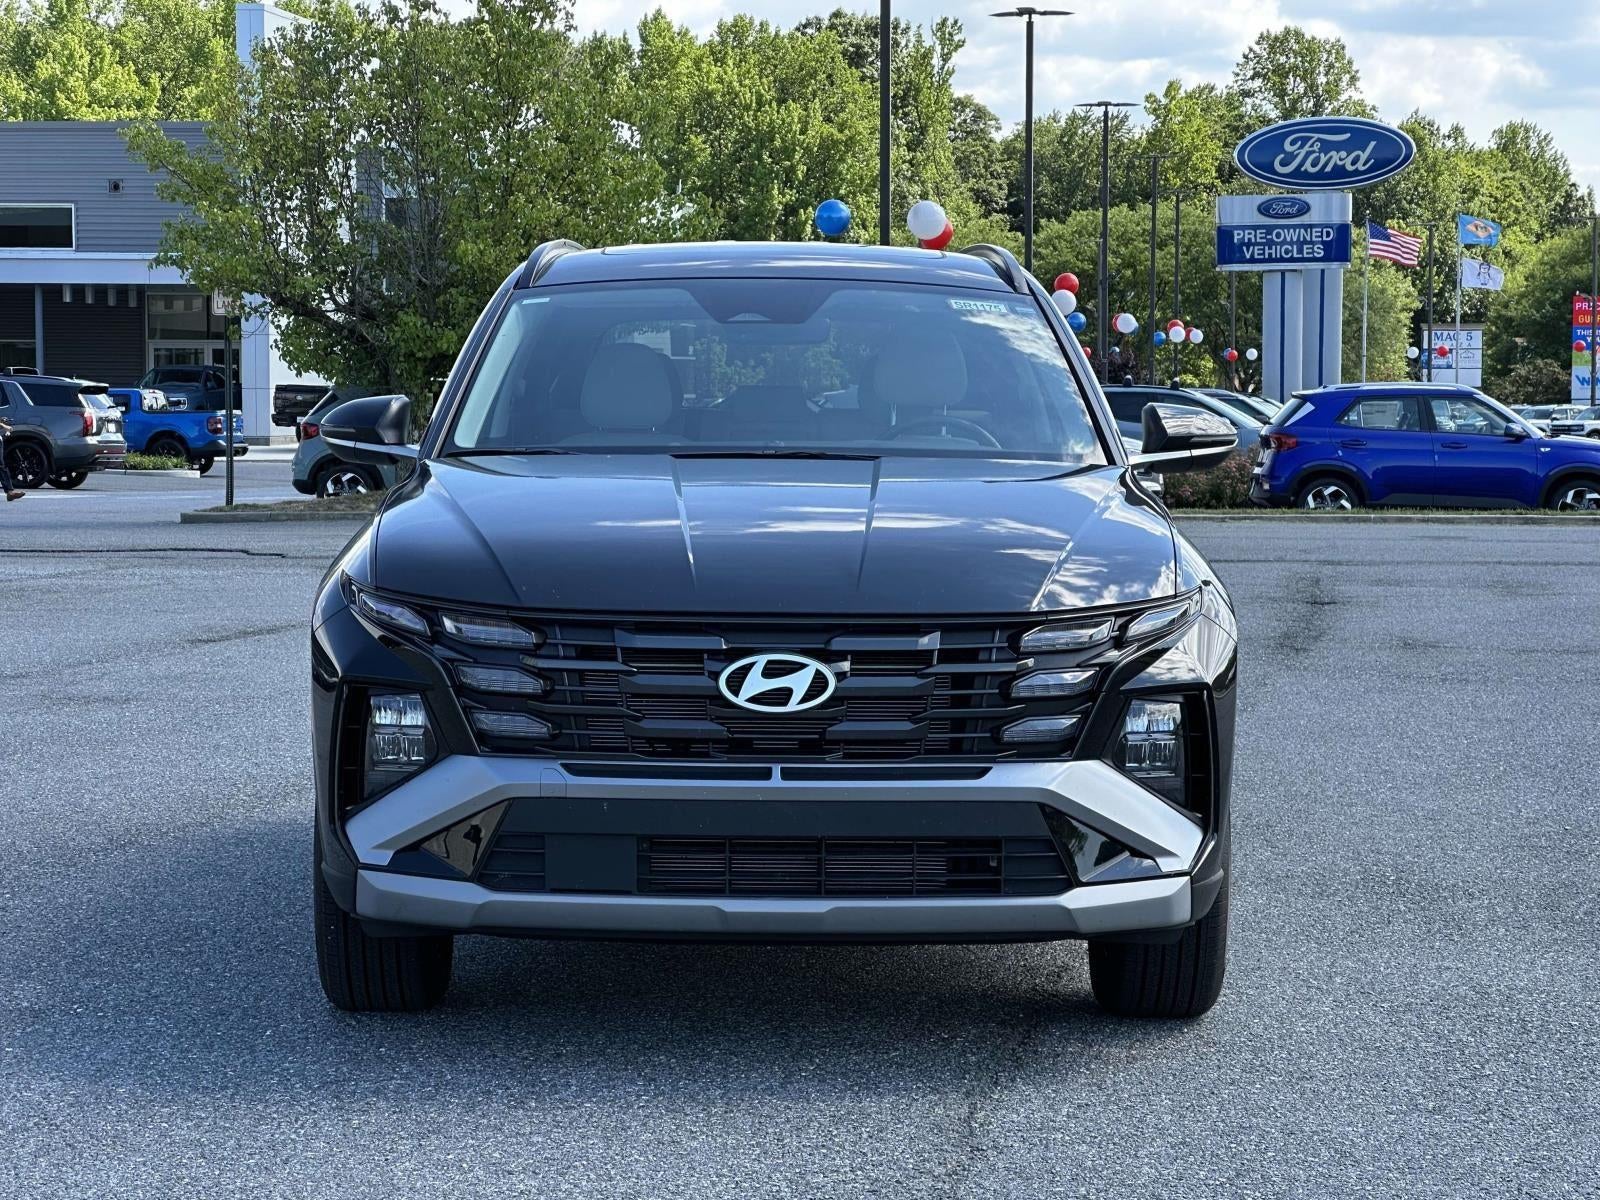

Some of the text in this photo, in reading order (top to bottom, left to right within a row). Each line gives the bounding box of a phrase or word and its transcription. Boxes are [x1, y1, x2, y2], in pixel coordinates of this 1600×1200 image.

[1273, 132, 1377, 174] Ford
[1269, 201, 1299, 215] Ford
[1233, 228, 1334, 243] PRE-OWNED
[1242, 244, 1325, 259] VEHICLES
[953, 301, 1002, 312] SR1175
[1465, 331, 1473, 342] 5
